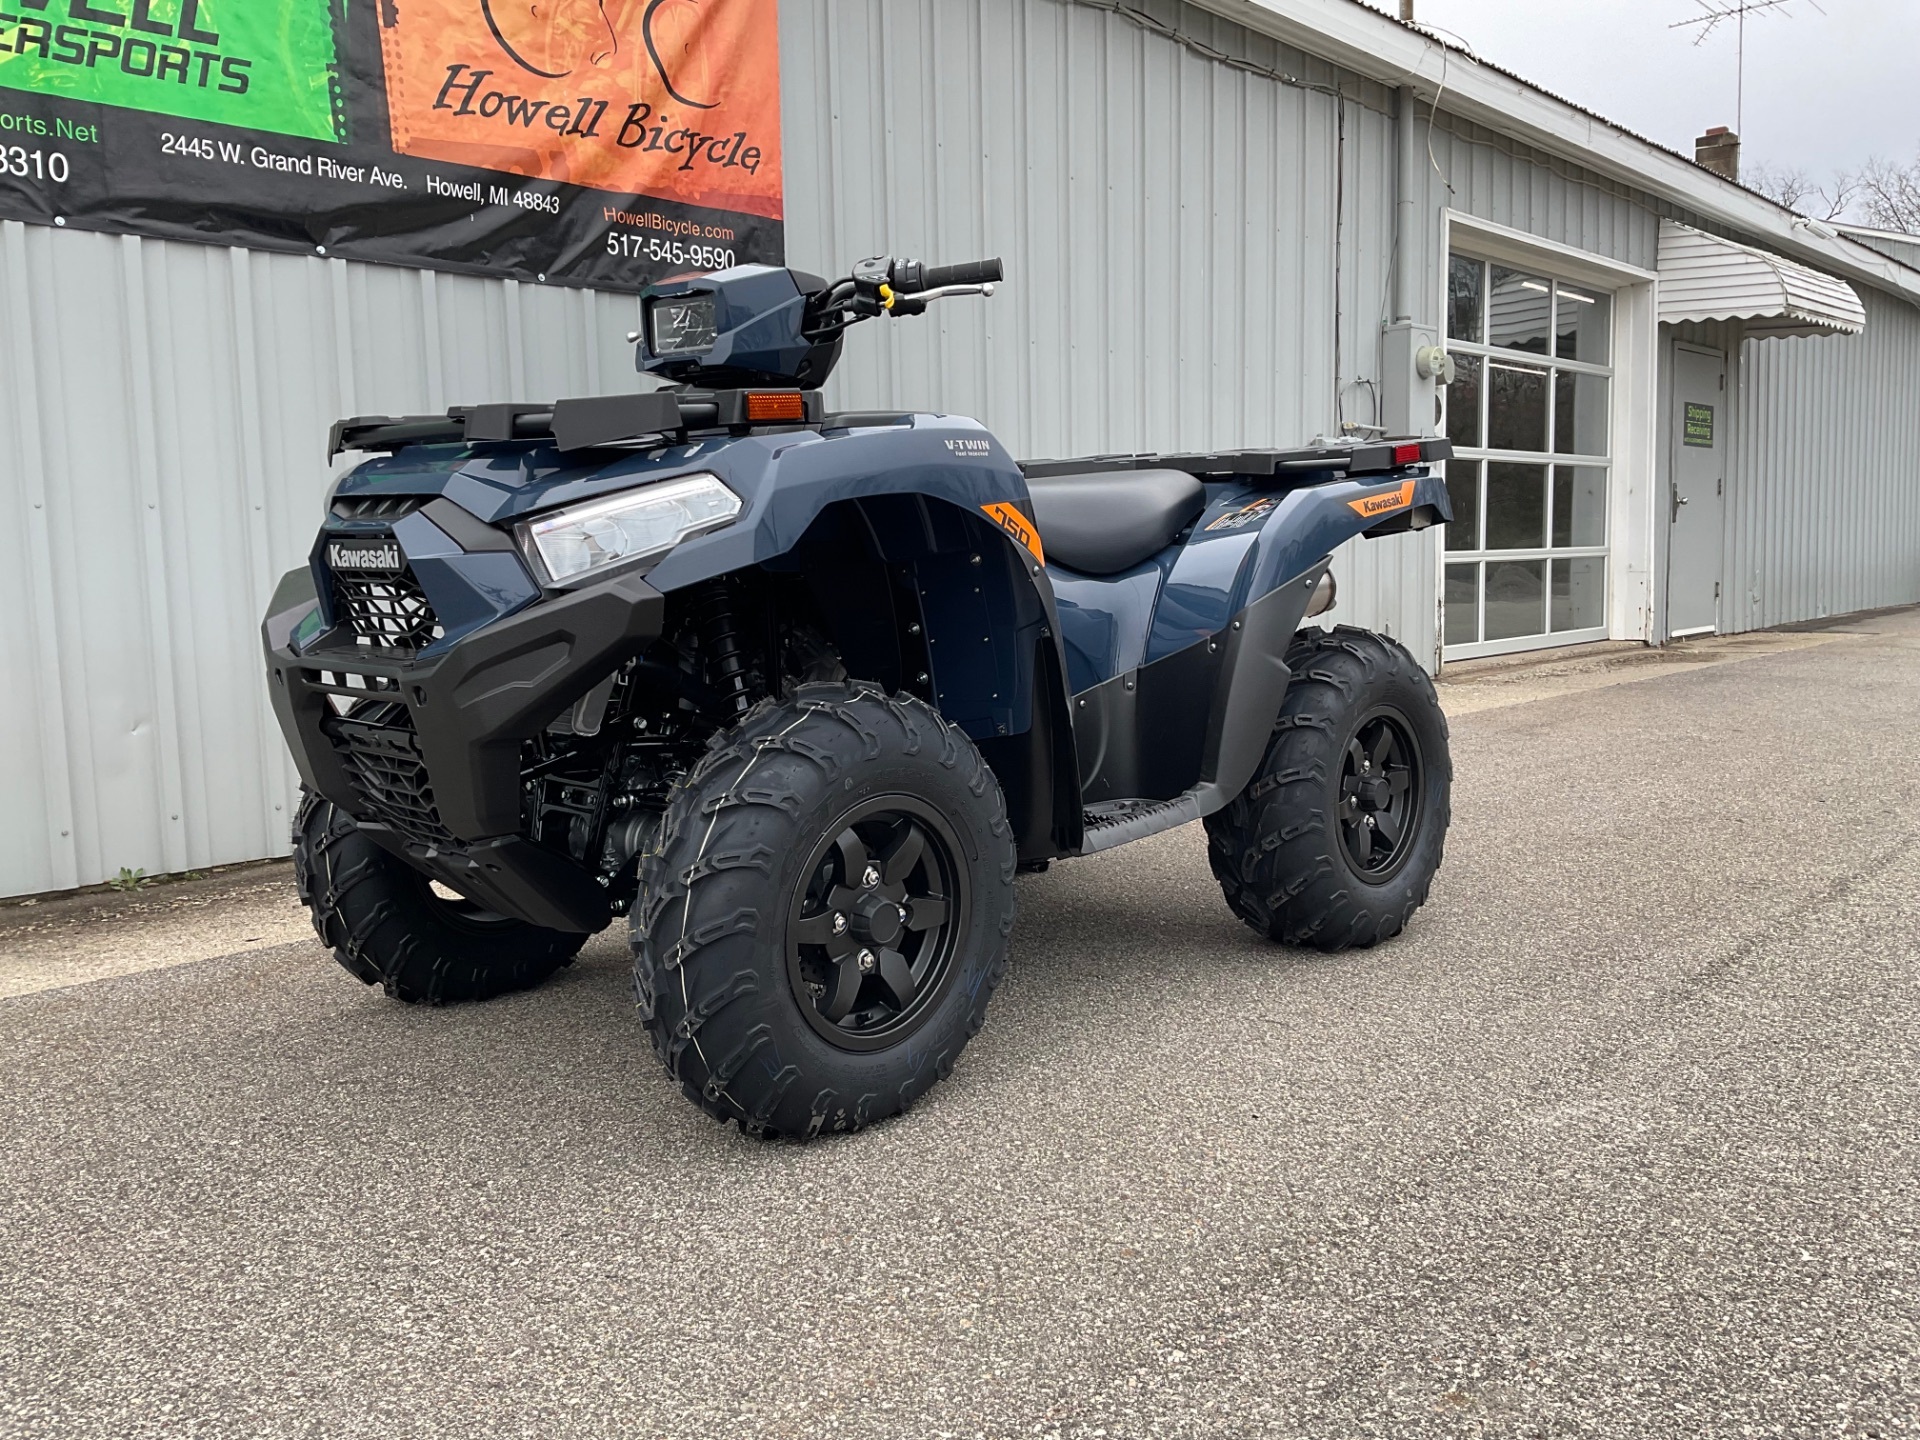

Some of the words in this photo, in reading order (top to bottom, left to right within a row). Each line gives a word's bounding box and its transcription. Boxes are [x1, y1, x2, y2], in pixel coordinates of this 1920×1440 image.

[432, 63, 608, 138] Howell
[616, 103, 762, 174] Bicycle
[161, 132, 214, 160] 2445
[218, 141, 245, 165] W.
[251, 147, 312, 175] Grand
[317, 157, 365, 183] River
[369, 166, 408, 190] Ave.
[426, 174, 485, 206] Howell,
[489, 185, 508, 206] MI
[513, 190, 560, 215] 48843
[603, 206, 735, 241] HowellBicycle.com
[606, 231, 736, 270] 517-545-9590
[944, 439, 990, 450] V-TWIN
[1363, 493, 1404, 513] Kawasaki
[994, 505, 1031, 547] 750
[329, 544, 399, 569] Kawasaki
